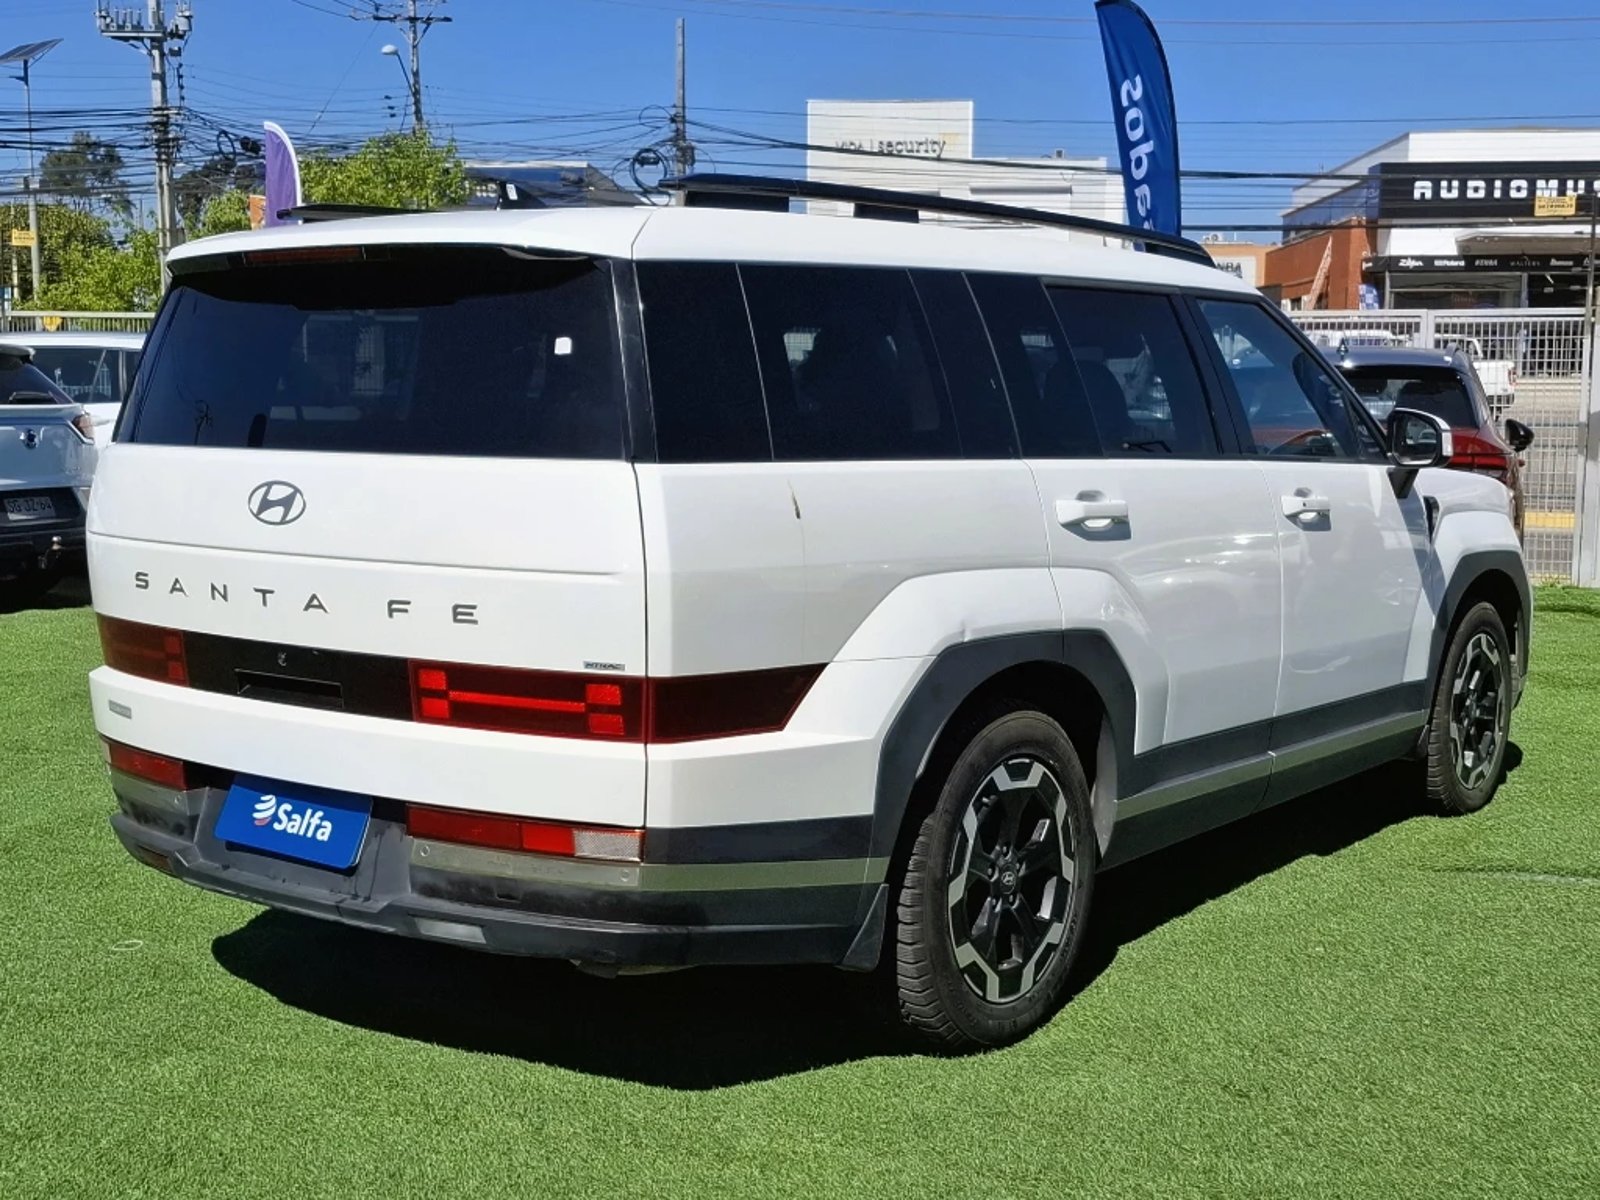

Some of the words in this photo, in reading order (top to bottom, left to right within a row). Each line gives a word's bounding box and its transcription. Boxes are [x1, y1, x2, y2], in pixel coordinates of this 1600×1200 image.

[878, 138, 946, 159] security
[135, 571, 329, 614] SANTA
[387, 599, 479, 625] FE
[273, 803, 332, 842] Salfa
